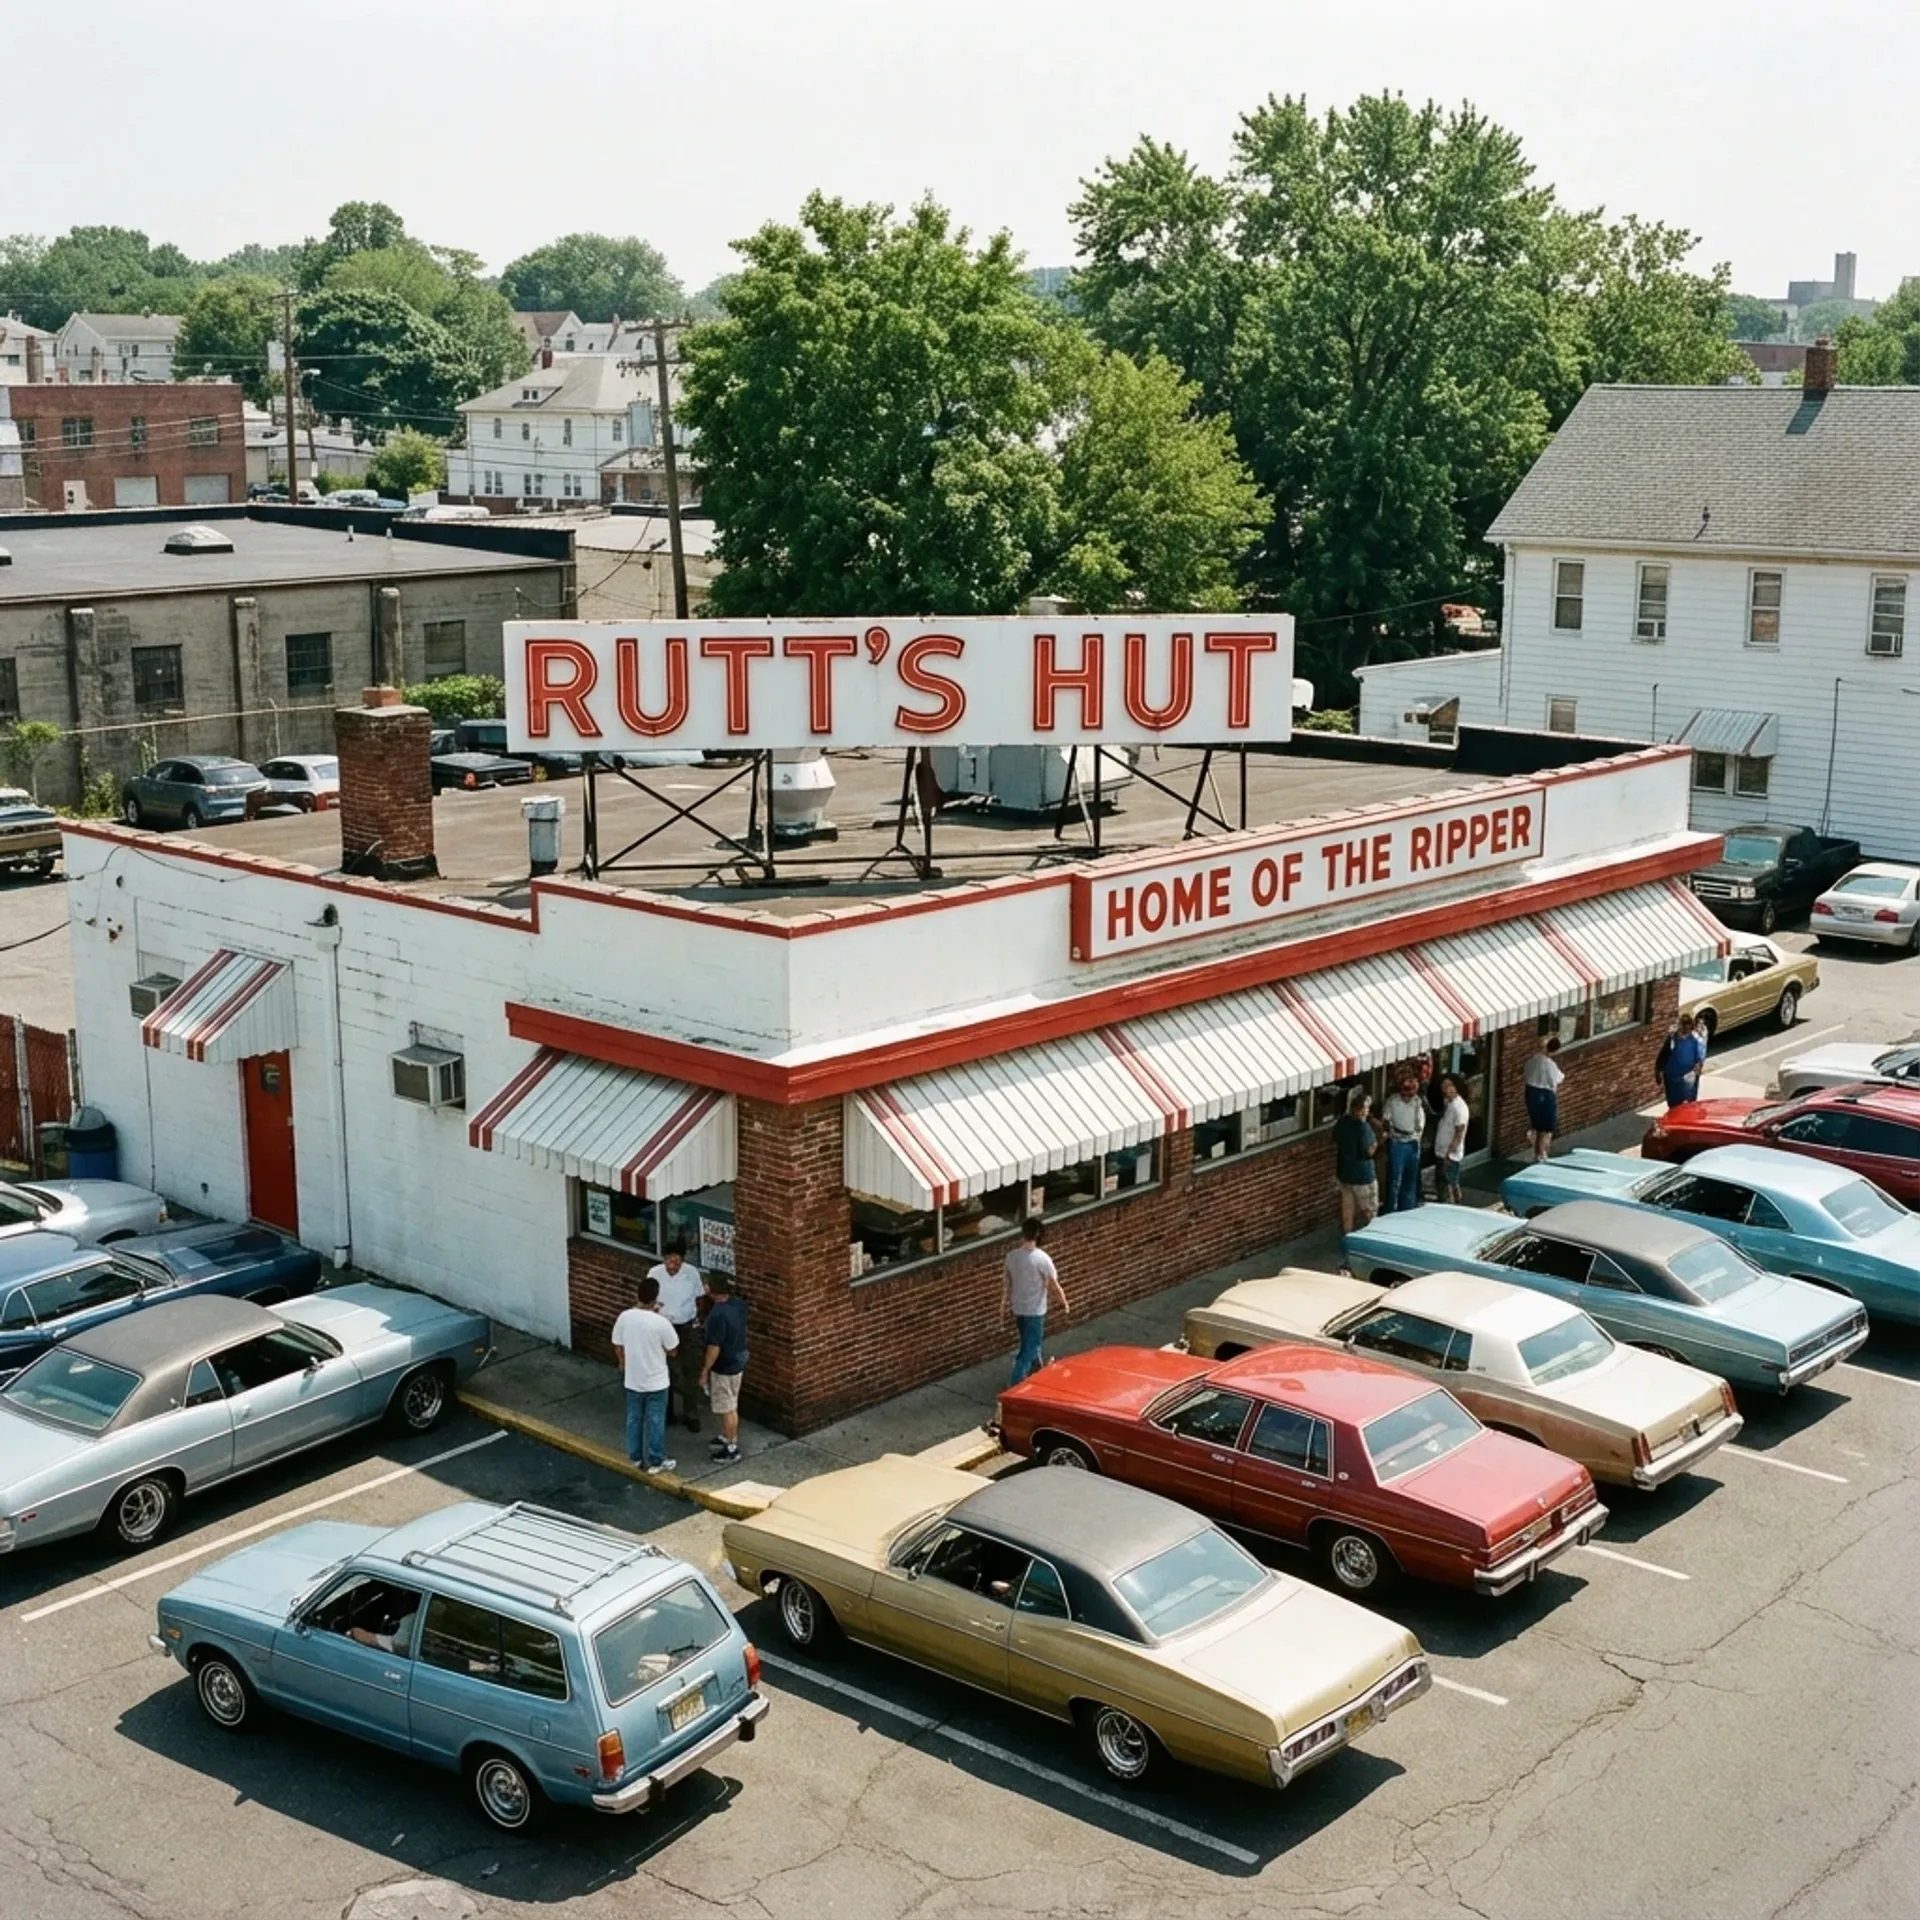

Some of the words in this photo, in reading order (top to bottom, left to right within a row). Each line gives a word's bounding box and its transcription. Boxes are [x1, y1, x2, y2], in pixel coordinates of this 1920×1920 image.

[523, 627, 968, 739] RUTT'S
[1031, 631, 1278, 735] HUT
[1106, 865, 1232, 941] HOME
[1251, 850, 1304, 908] OF
[1321, 832, 1393, 892] THE
[1410, 804, 1532, 872] RIPPER
